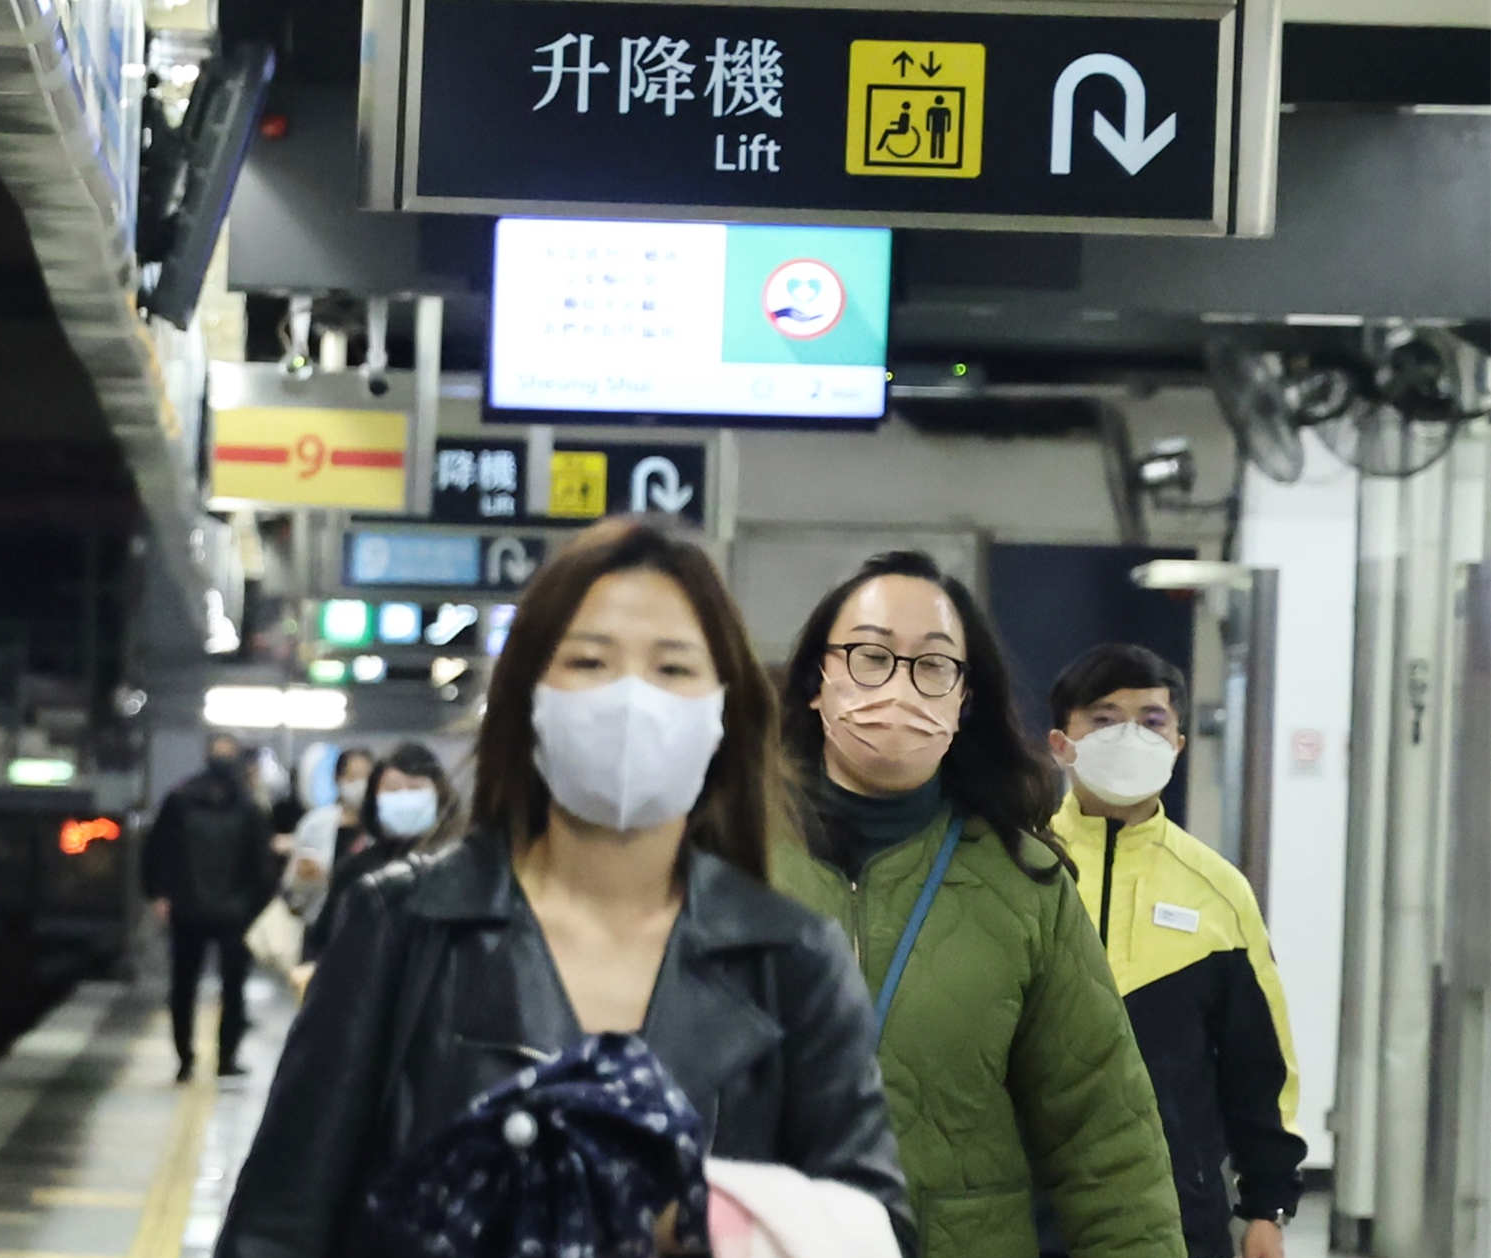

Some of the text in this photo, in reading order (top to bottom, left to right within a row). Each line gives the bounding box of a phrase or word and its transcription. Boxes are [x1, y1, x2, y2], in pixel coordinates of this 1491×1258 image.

[531, 32, 785, 118] 升降機
[715, 133, 782, 172] Lift
[296, 434, 326, 480] 9
